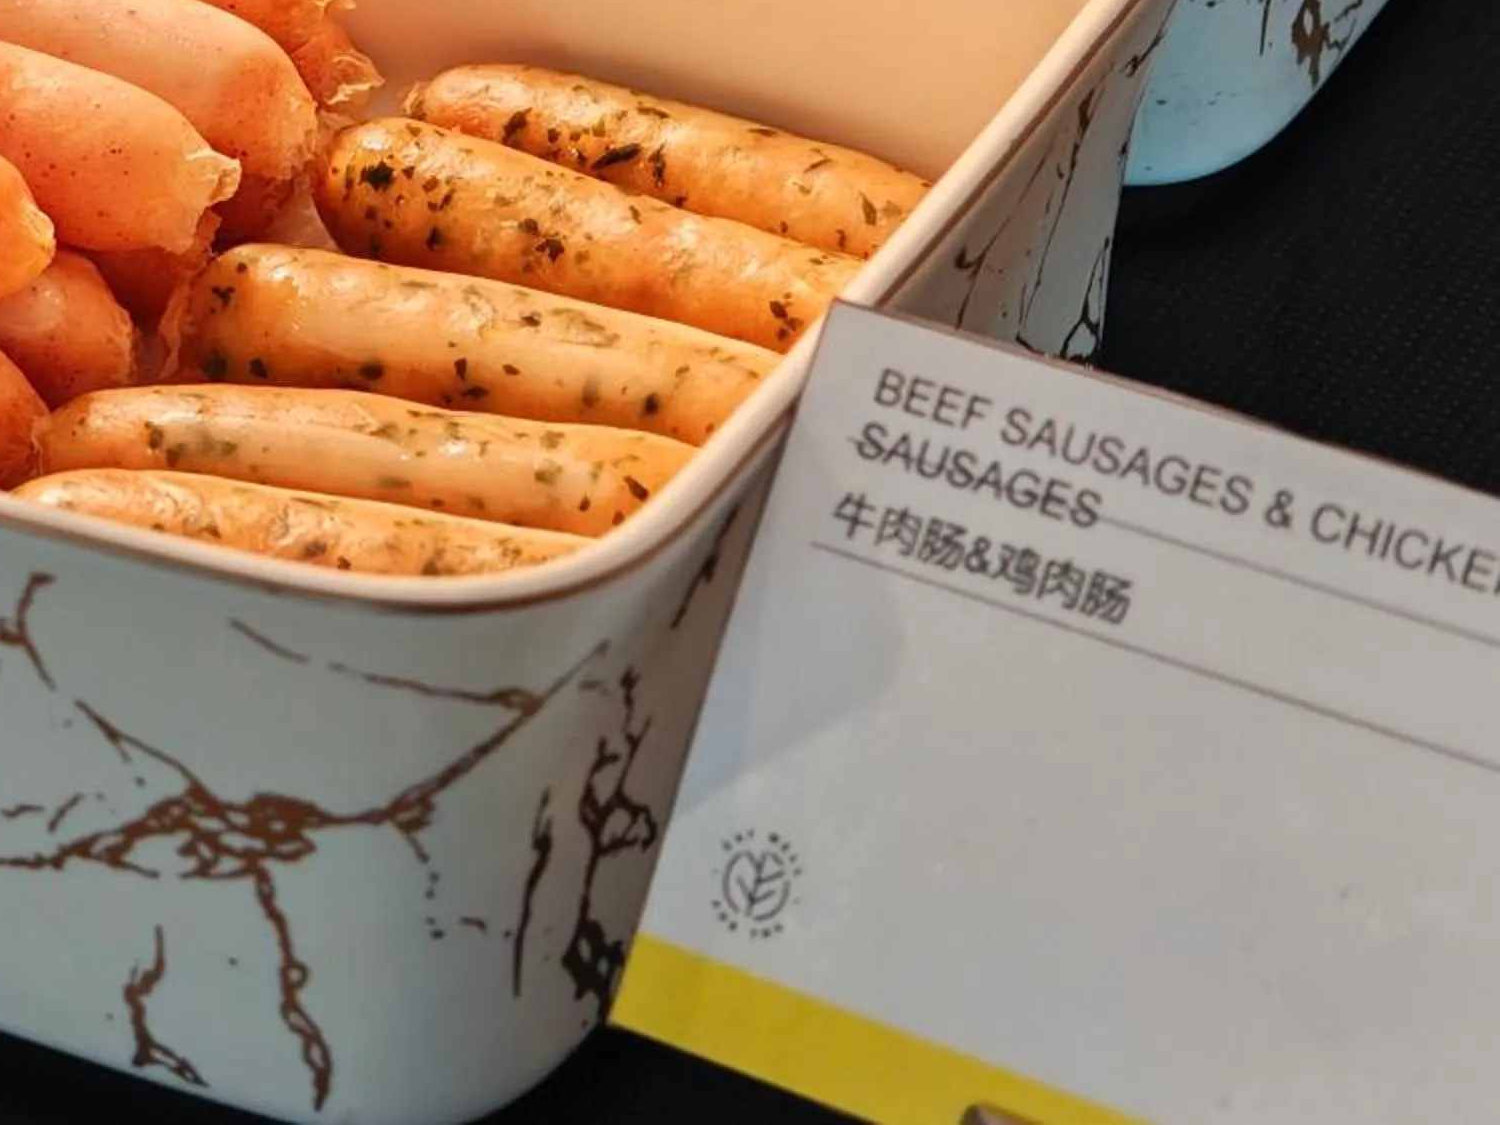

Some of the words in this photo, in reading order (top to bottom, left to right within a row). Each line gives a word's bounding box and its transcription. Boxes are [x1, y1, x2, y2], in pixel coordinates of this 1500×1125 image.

[854, 421, 1103, 528] SAUSAGES
[873, 367, 993, 429] BEEF
[999, 407, 1255, 515] SAUSAGES
[1263, 488, 1297, 530] &
[1310, 502, 1500, 596] CHICKE
[832, 491, 1133, 626] 牛肉肠&鸡肉肠
